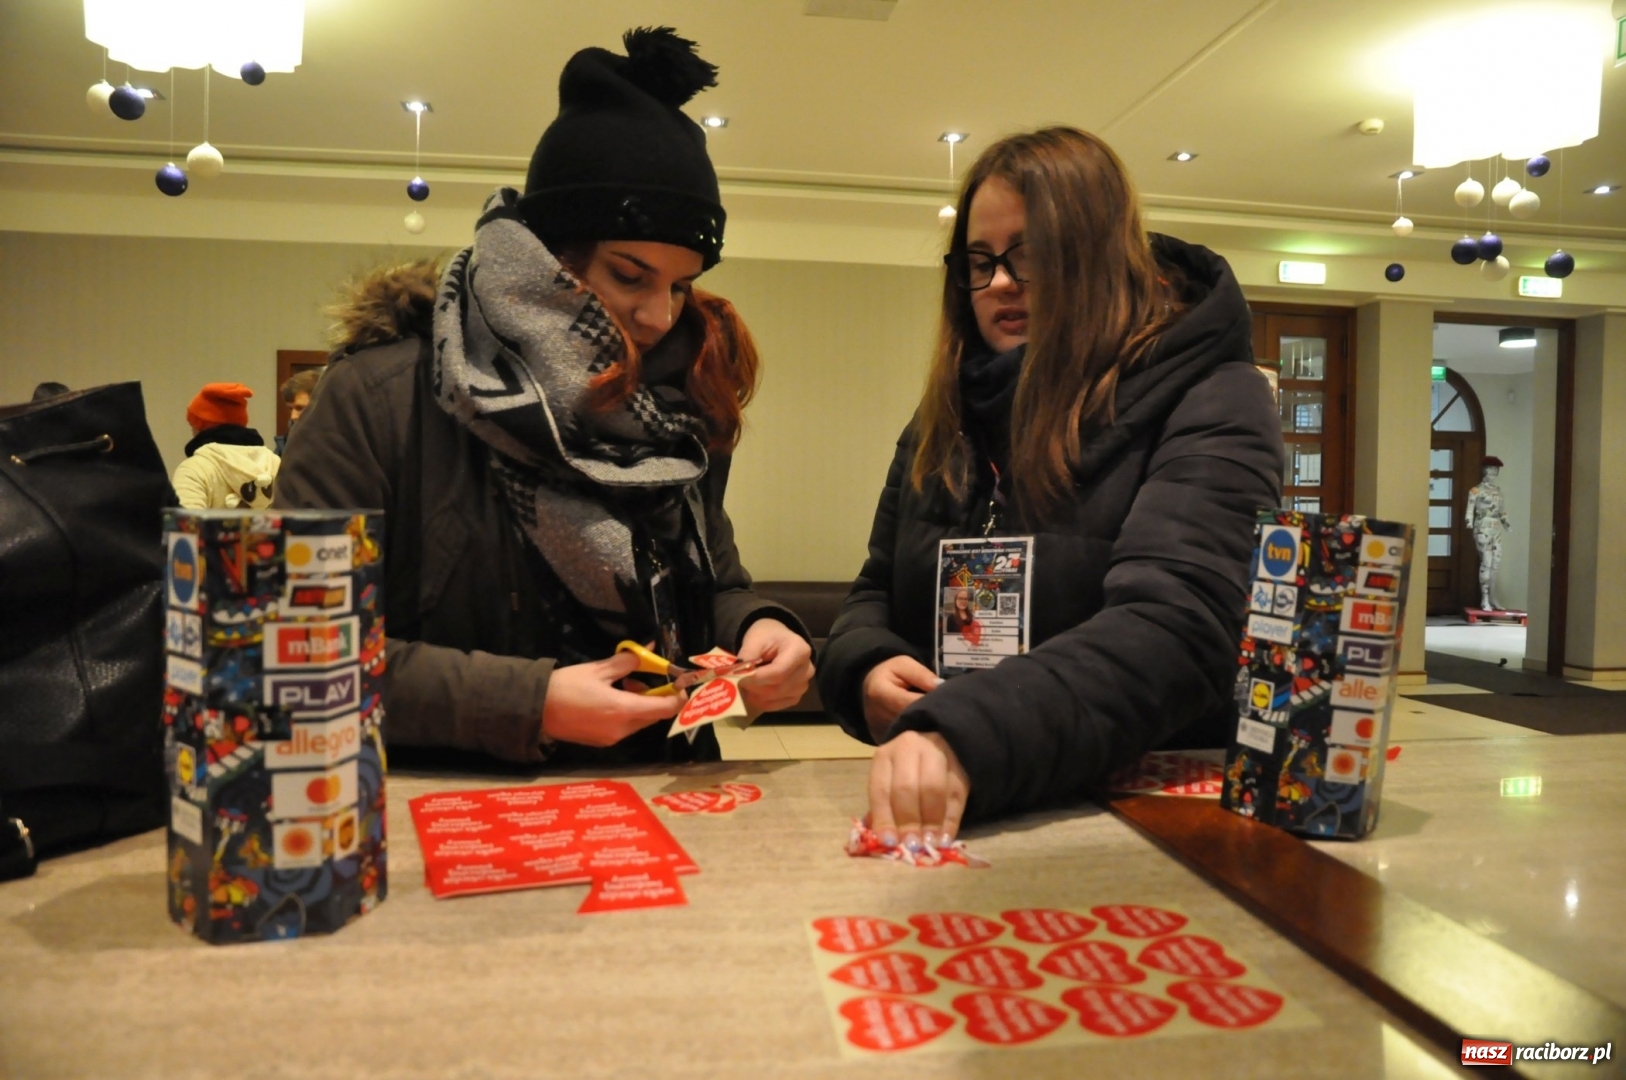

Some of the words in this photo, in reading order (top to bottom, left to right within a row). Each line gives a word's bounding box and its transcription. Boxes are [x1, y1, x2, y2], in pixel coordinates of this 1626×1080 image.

[1267, 542, 1292, 562] tvn
[1252, 619, 1289, 637] player
[278, 679, 352, 706] PLAY
[276, 726, 356, 758] allegro
